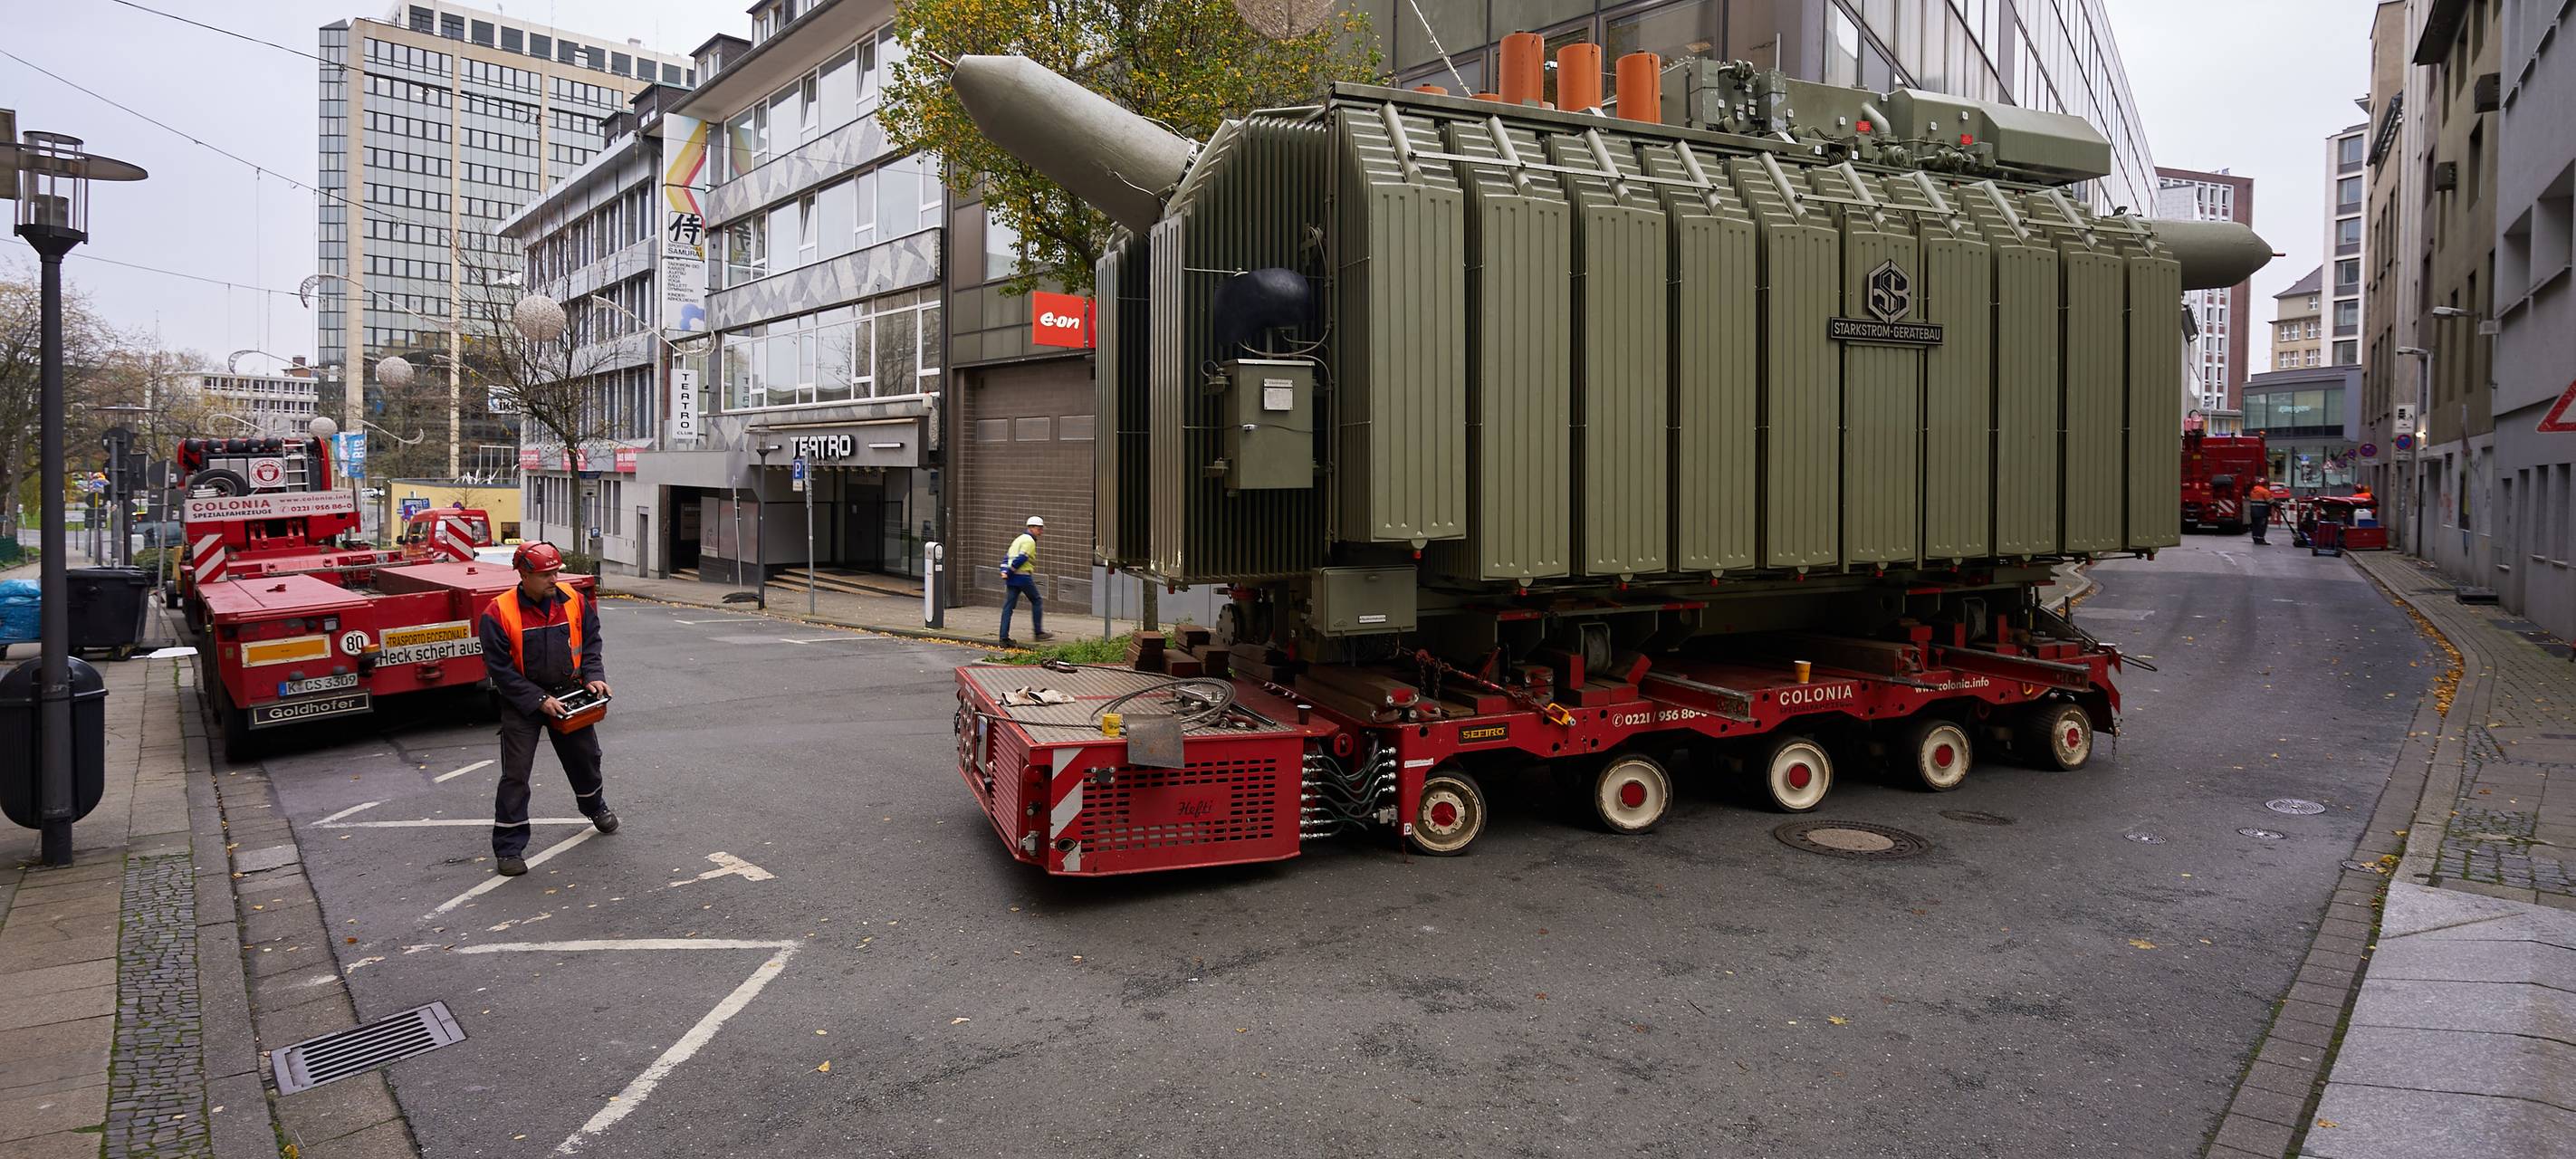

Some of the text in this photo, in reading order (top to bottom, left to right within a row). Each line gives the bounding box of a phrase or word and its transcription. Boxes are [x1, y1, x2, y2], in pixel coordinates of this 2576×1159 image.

[669, 214, 702, 244] 侍
[668, 248, 702, 257] SAMURAI
[681, 374, 690, 429] TEATRO
[790, 435, 852, 460] TEATRO
[795, 462, 801, 478] P
[192, 500, 271, 512] COLONIA
[279, 494, 352, 503] www.colonia.info
[192, 509, 272, 520] SPEZIALFAHRZEUGE
[346, 635, 364, 651] 80
[388, 628, 467, 647] TRASPORTO ECCEZIONALE
[380, 641, 482, 666] Heck schert aus
[288, 675, 357, 694] K CS 3309
[1779, 685, 1853, 705] COLONIA
[269, 698, 355, 719] Goldhofer
[1625, 713, 1650, 725] 0221
[1659, 710, 1679, 722] 956
